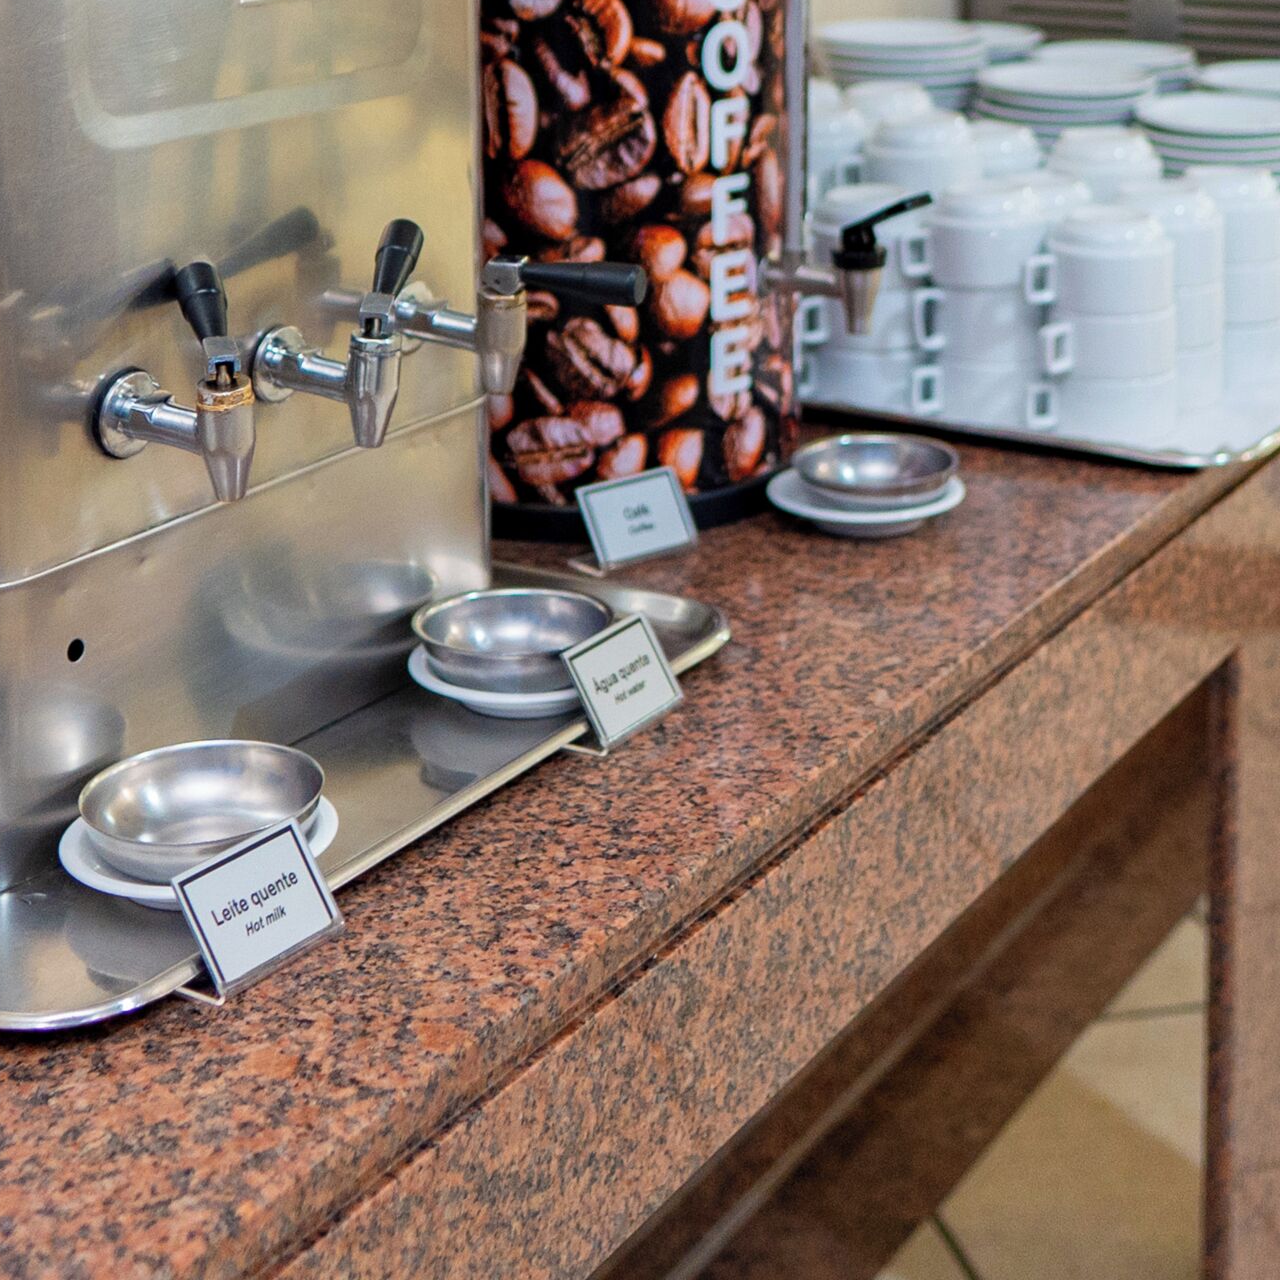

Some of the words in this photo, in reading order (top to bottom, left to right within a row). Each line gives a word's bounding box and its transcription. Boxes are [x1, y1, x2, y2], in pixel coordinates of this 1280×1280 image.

[619, 654, 650, 681] quente
[614, 690, 627, 705] Hot
[628, 680, 646, 696] water
[211, 897, 249, 927] Leite
[251, 872, 297, 906] quente
[245, 918, 265, 936] Hot
[266, 905, 287, 927] milk
